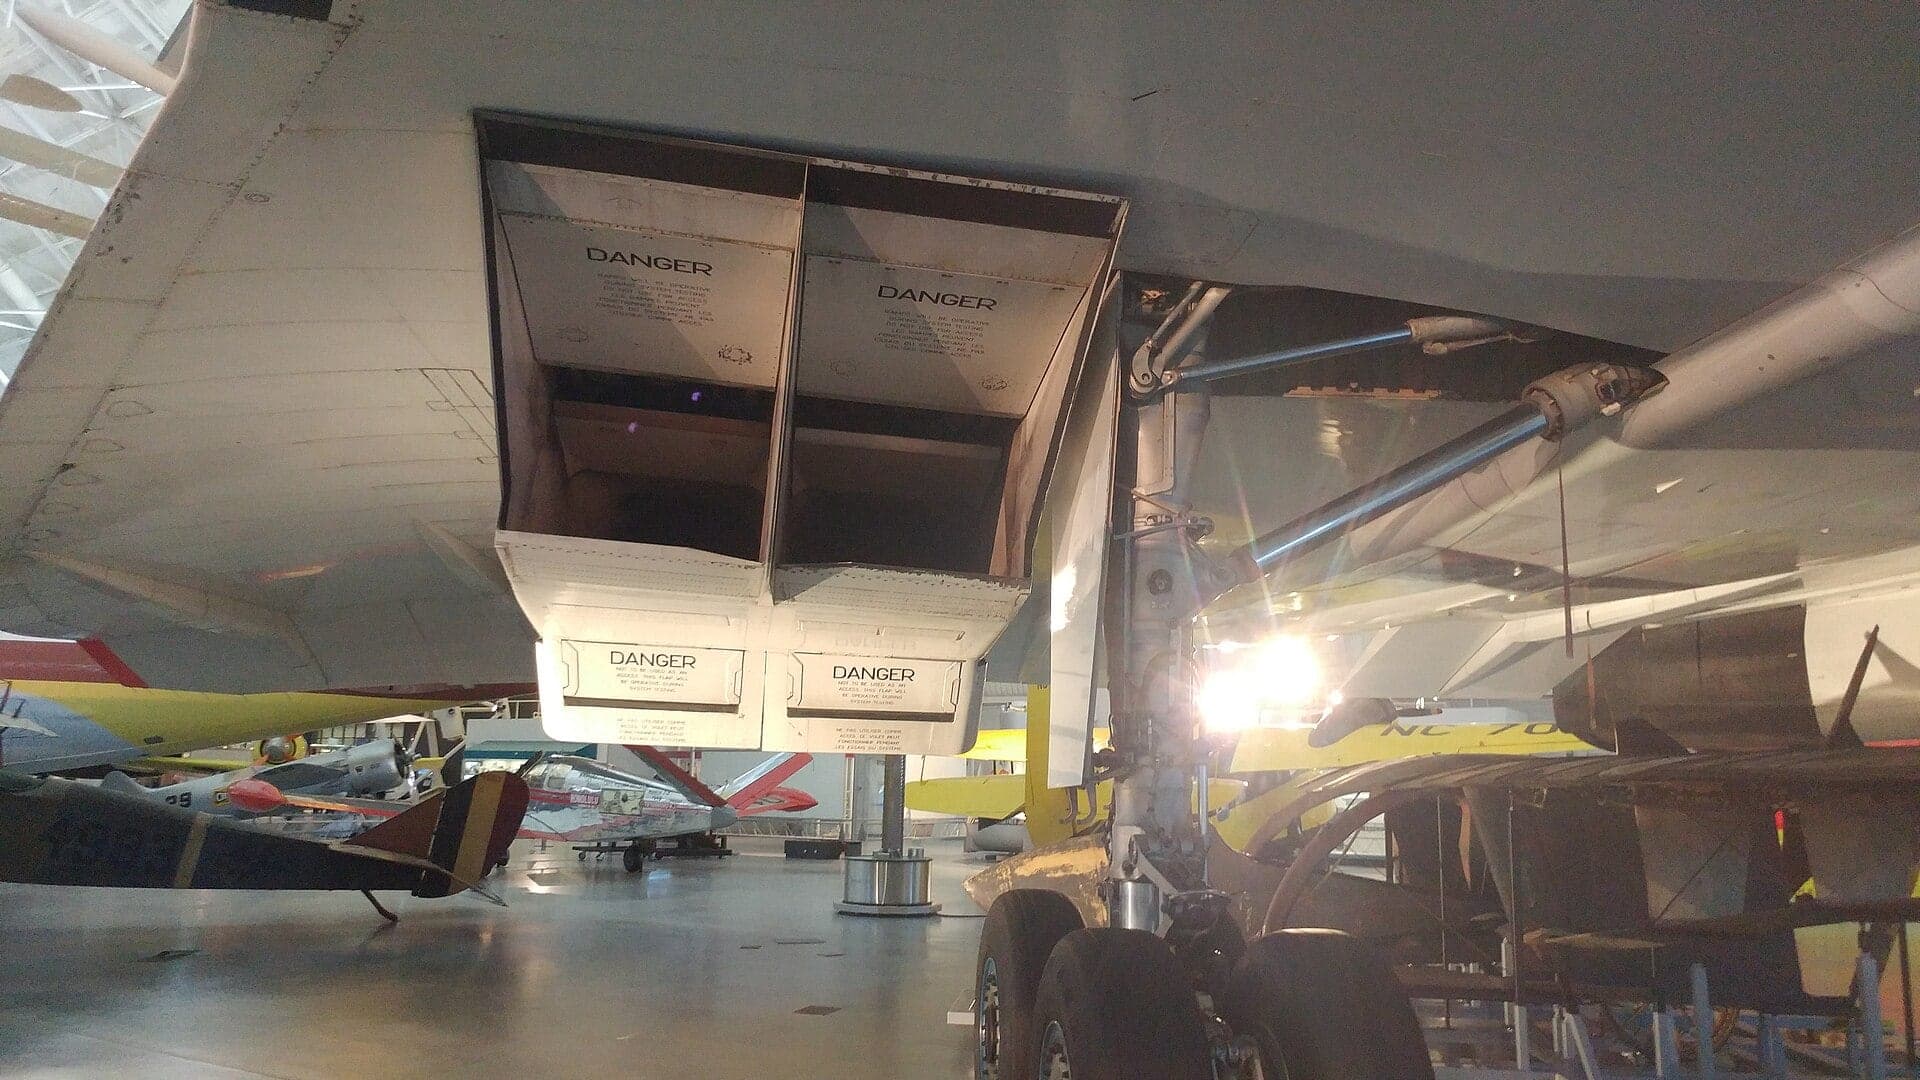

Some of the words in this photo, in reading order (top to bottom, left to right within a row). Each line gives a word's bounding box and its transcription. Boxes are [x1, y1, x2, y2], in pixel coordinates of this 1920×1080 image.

[587, 247, 713, 277] DANGER
[878, 285, 997, 311] DANGER
[610, 651, 696, 669] DANGER
[833, 665, 915, 682] DANGER
[1380, 721, 1452, 737] NC
